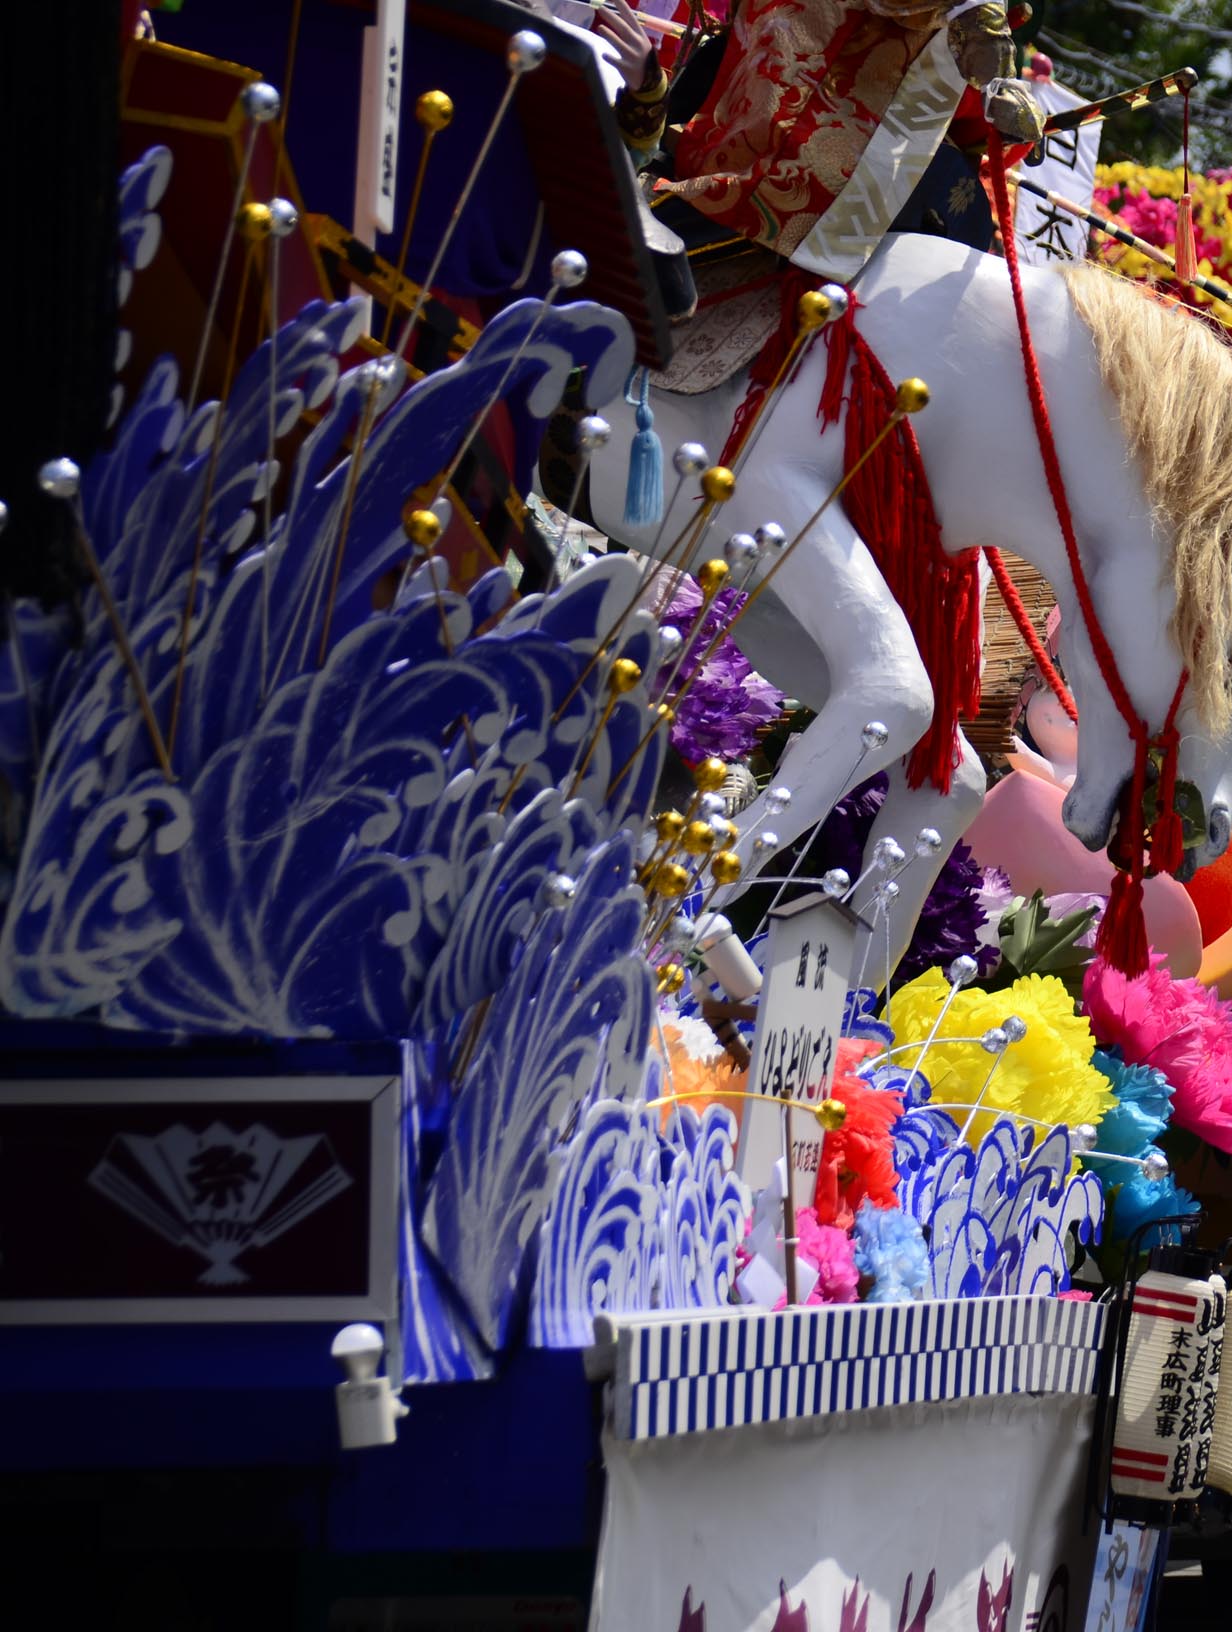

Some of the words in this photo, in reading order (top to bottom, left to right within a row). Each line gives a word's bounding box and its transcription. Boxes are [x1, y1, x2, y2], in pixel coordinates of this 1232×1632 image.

[795, 940, 829, 991] 風流
[760, 1024, 833, 1101] ひよどりごえ
[185, 1143, 261, 1210] 祭
[1154, 1326, 1193, 1438] 末広町理事
